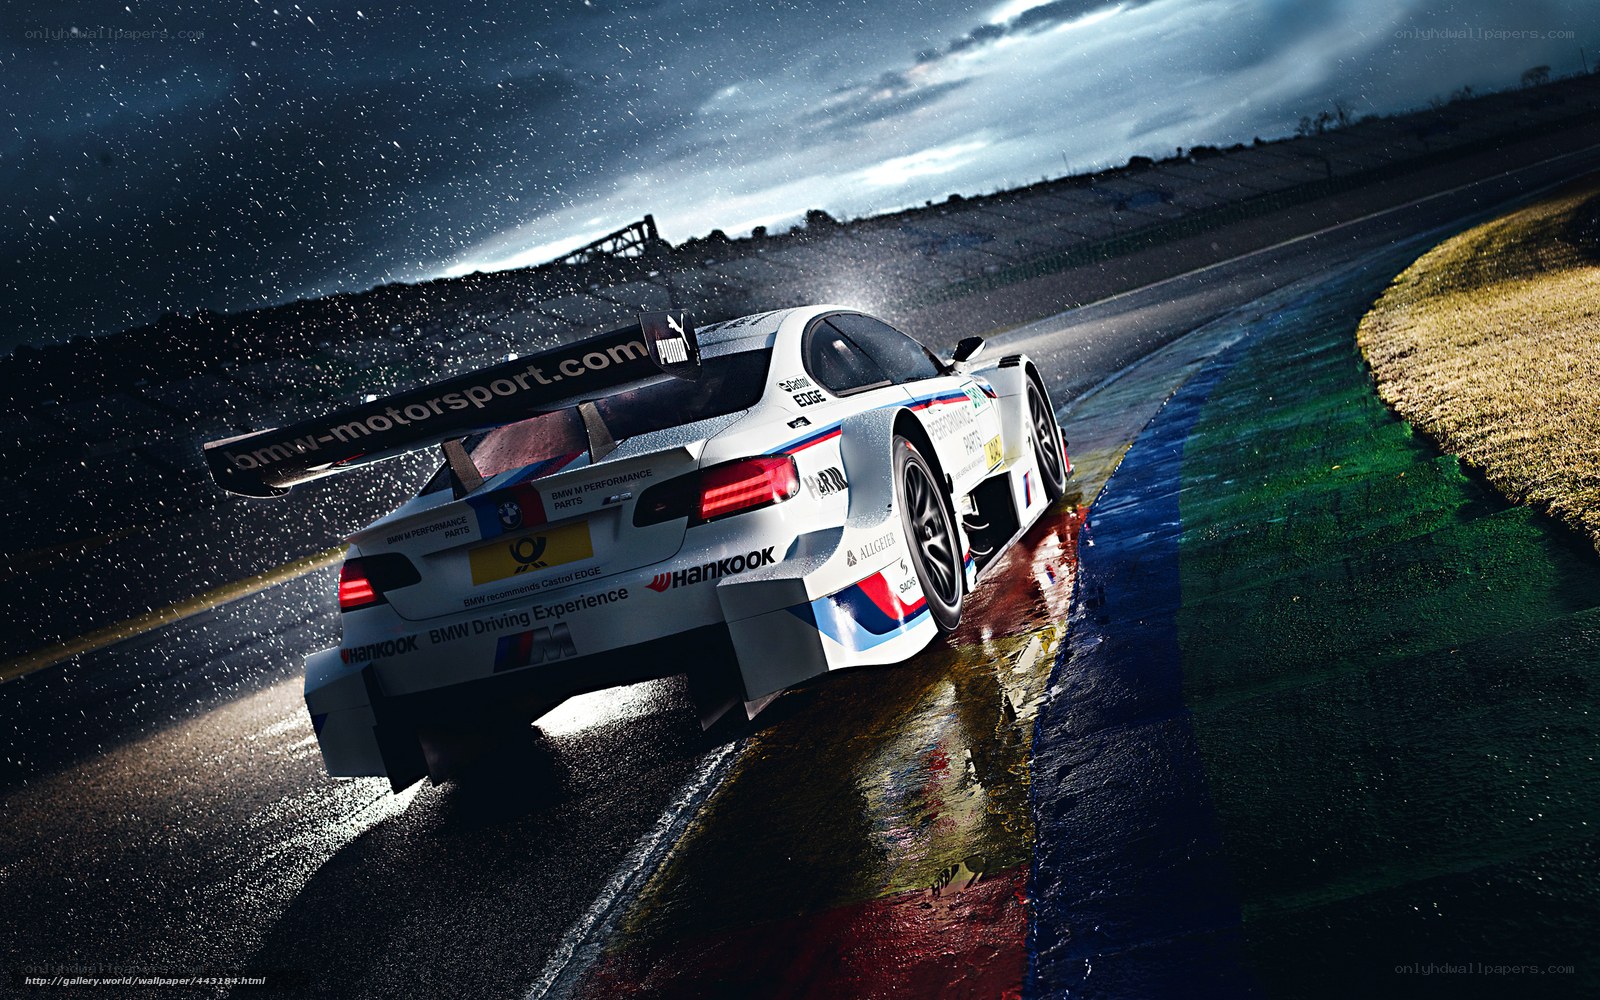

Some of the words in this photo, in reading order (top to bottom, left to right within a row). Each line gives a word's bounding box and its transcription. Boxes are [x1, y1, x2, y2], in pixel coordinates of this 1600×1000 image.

[223, 336, 650, 471] bmw-motorsport.com
[792, 390, 826, 407] EDGE
[927, 405, 973, 443] PERFORMANCE
[963, 430, 982, 456] PARTS
[551, 488, 574, 501] BMW
[574, 486, 583, 496] M
[584, 469, 653, 493] PERFORMANCE
[554, 497, 583, 510] PARTS
[386, 534, 404, 545] BMW
[404, 531, 412, 540] M
[411, 516, 468, 539] PERFORMANCE
[444, 526, 470, 539] PARTS
[860, 532, 896, 560] ALLGEIER
[463, 595, 487, 608] BMW
[487, 583, 541, 602] recommends
[541, 574, 574, 588] Castrol
[575, 566, 602, 580] EDGE
[429, 623, 469, 644] BMW
[472, 612, 530, 636] Driving
[533, 587, 630, 621] Experience
